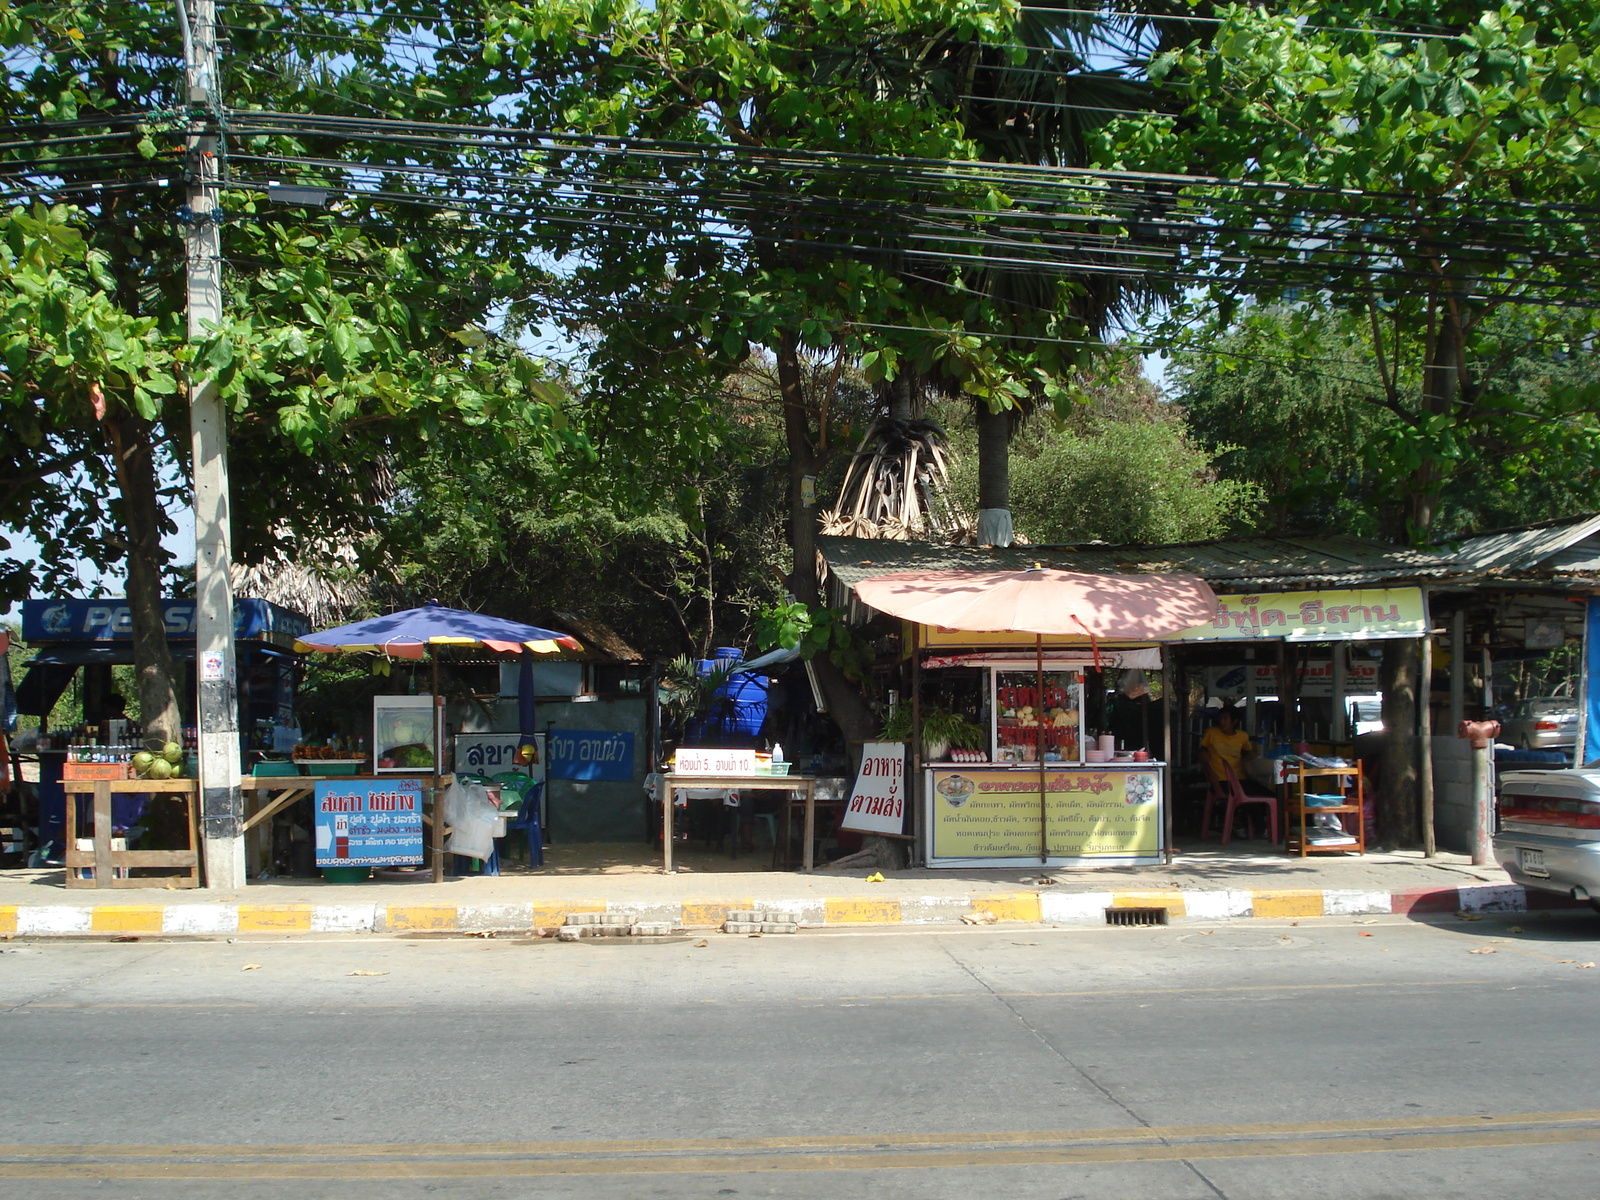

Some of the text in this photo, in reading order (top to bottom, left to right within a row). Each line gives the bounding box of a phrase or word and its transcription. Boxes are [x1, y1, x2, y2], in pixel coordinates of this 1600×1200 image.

[83, 606, 197, 633] PESI
[862, 757, 902, 778] อาหาร
[321, 790, 415, 812] ส้มตำ ไก่ย่าง
